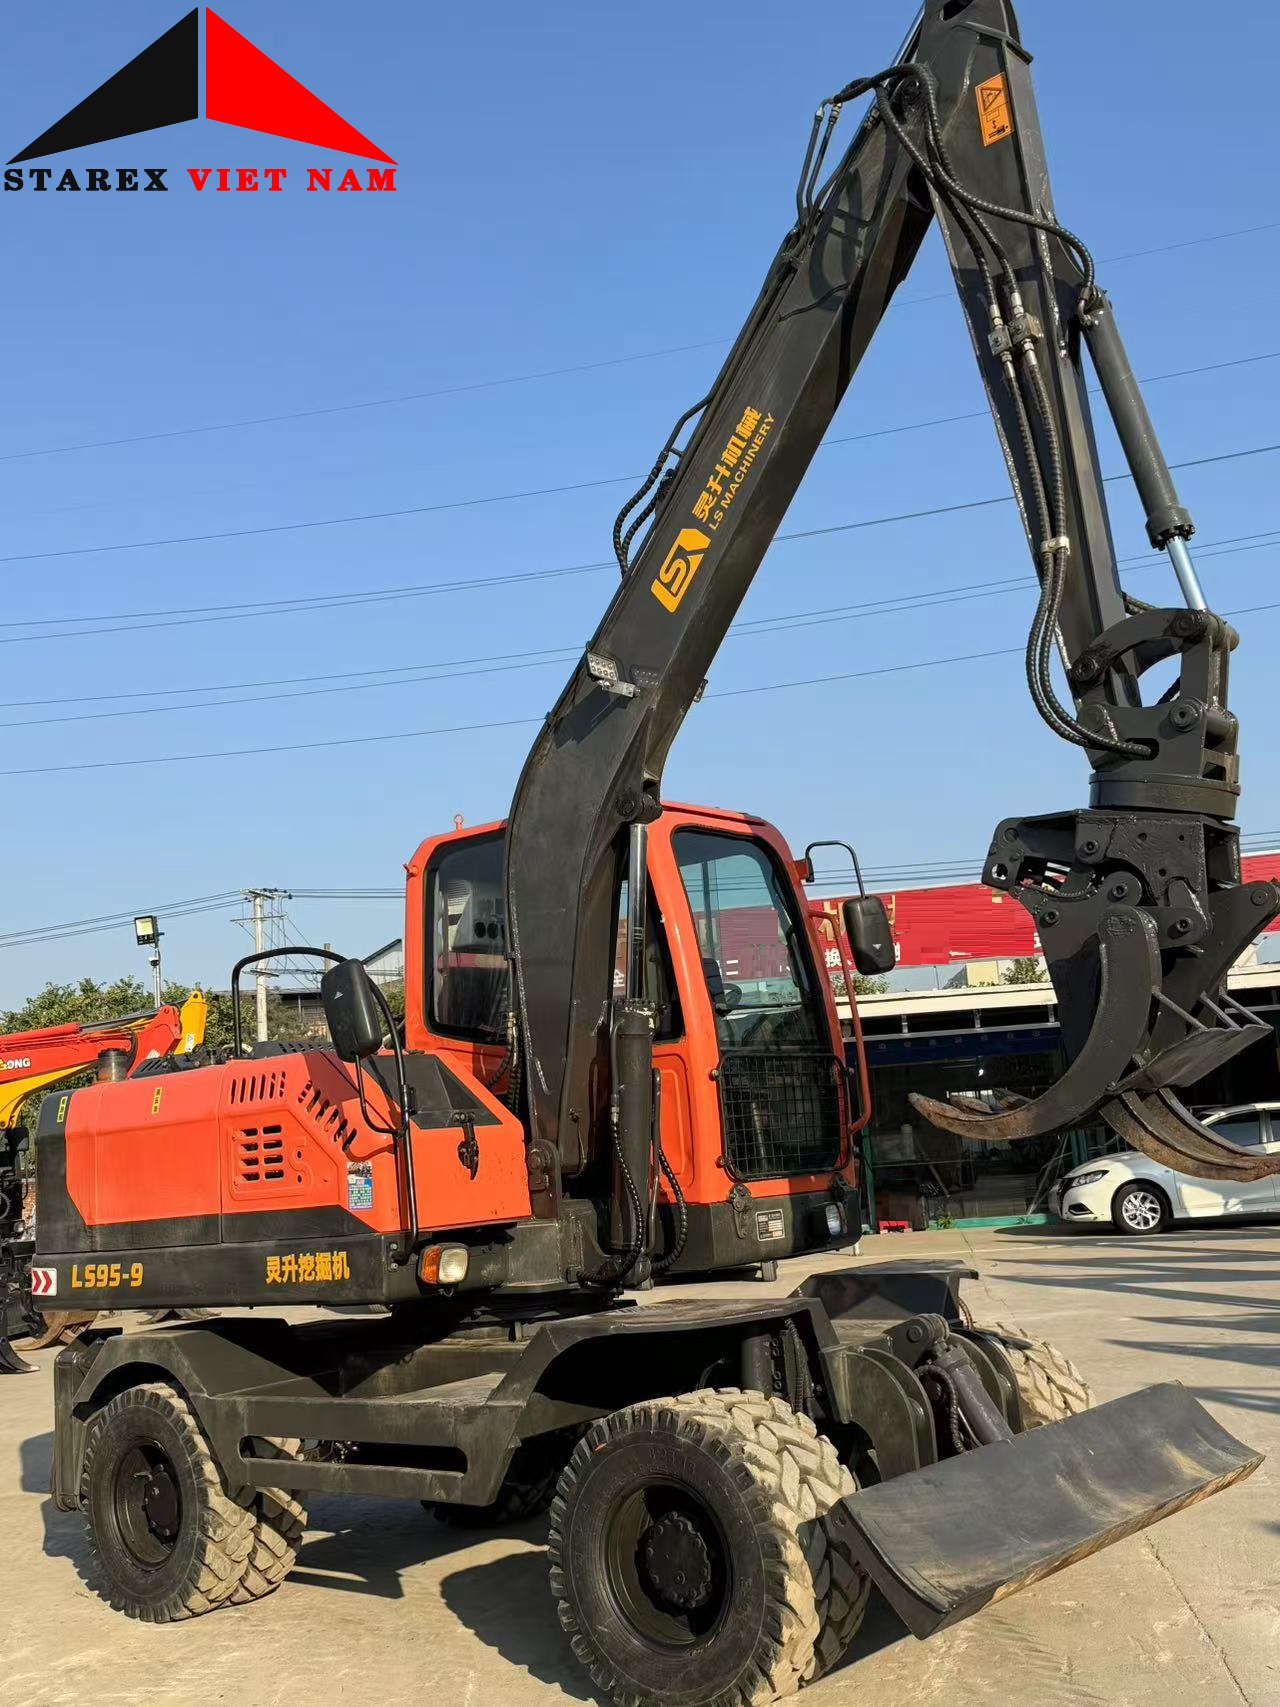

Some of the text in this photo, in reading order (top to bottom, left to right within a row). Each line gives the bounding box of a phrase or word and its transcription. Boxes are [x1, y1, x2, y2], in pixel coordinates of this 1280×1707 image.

[692, 406, 762, 523] 灵升机械
[709, 412, 775, 531] LS MACHINERY
[71, 1263, 144, 1288] LS95-9
[265, 1251, 351, 1285] 灵升挖掘机
